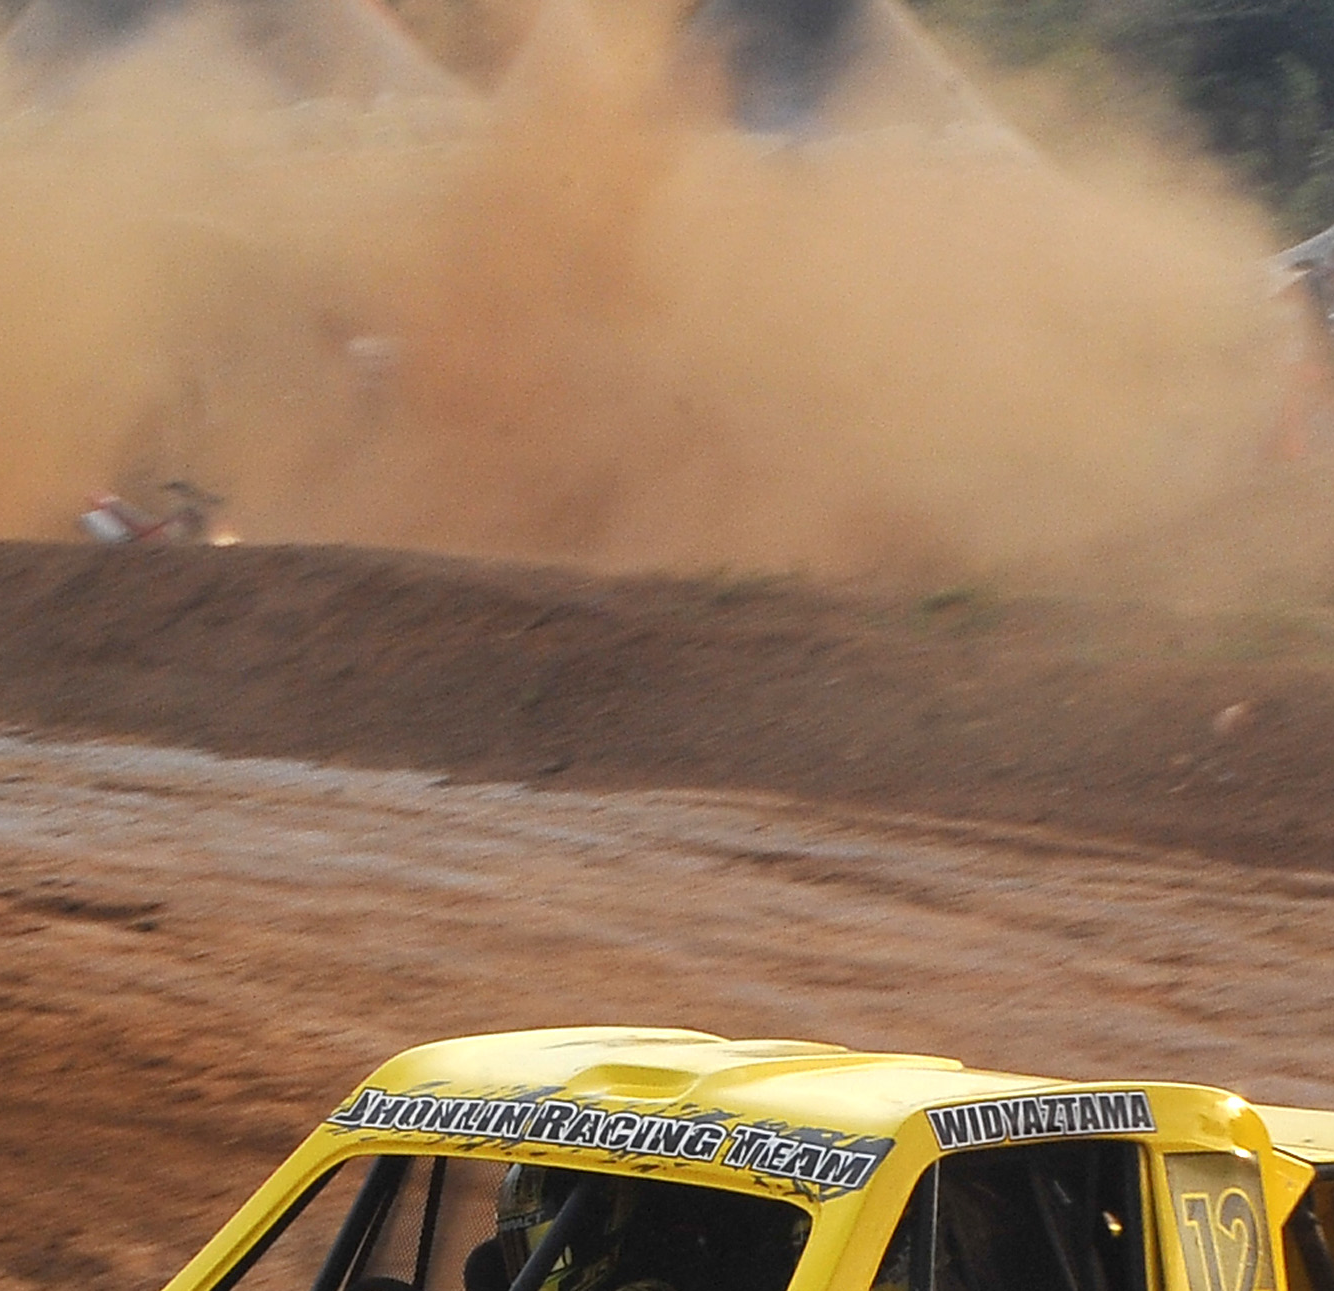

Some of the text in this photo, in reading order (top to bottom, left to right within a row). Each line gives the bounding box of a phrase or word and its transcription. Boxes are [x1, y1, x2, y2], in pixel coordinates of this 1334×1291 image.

[328, 1090, 876, 1188] JHONLIN RACING TEAM
[928, 1091, 1156, 1150] WIDYAZTAMA
